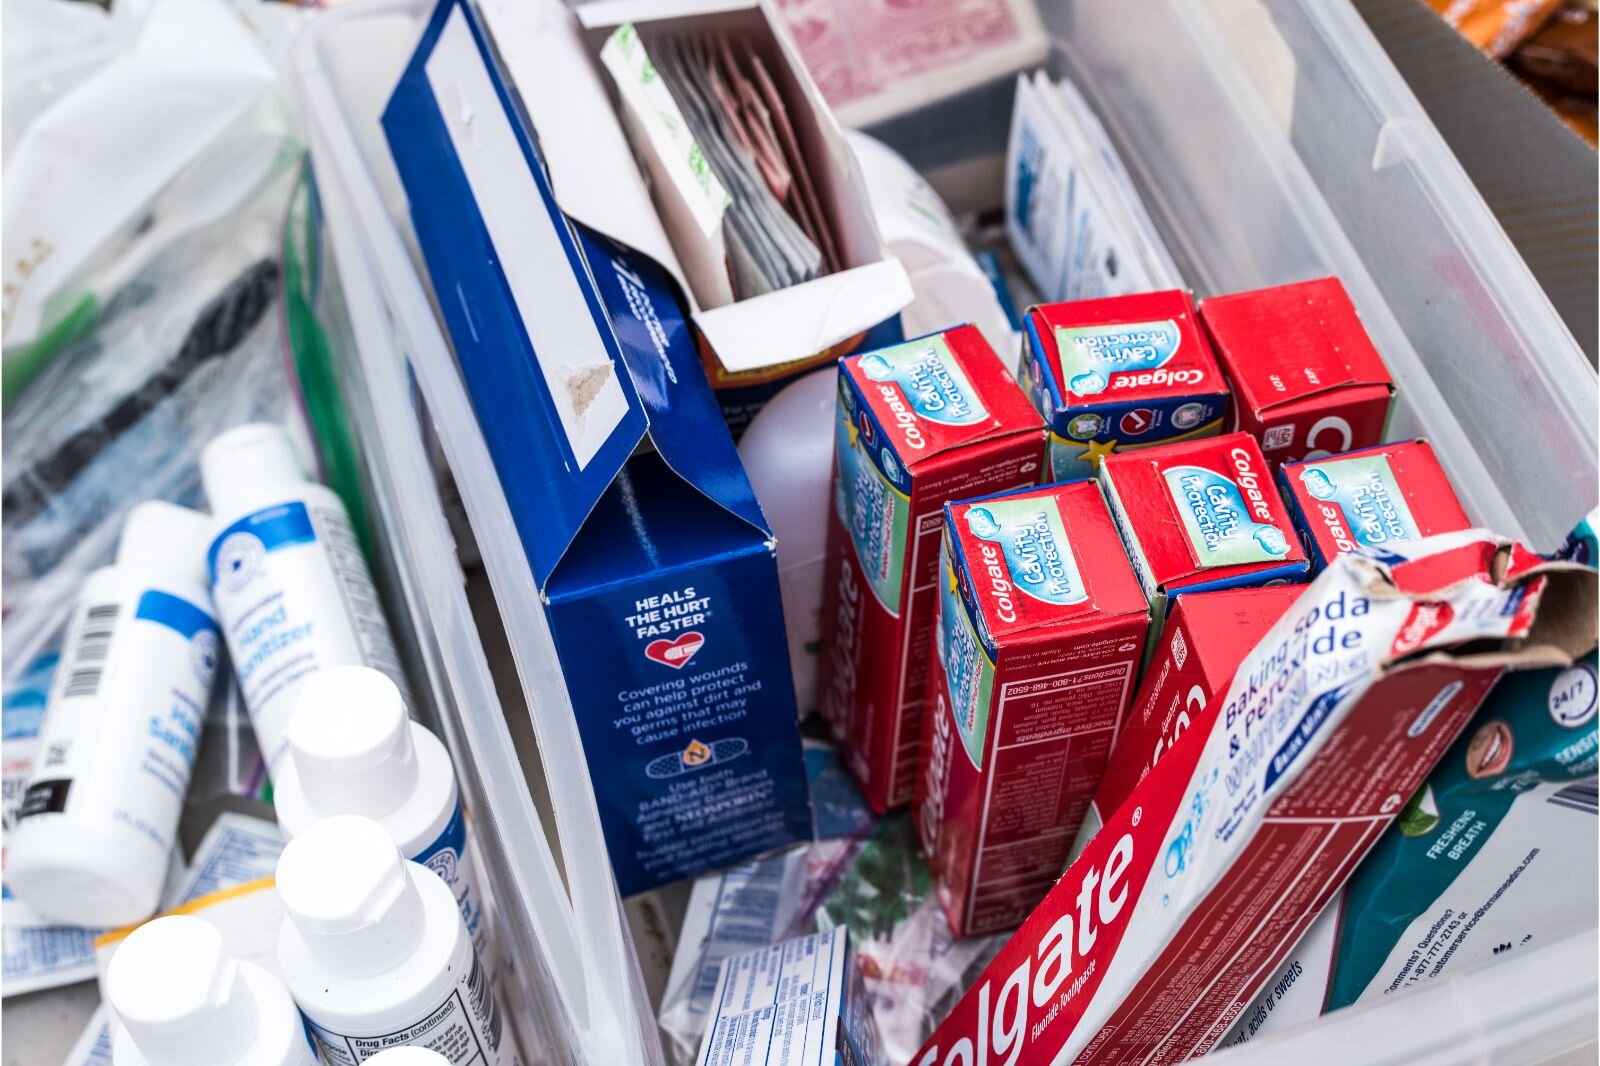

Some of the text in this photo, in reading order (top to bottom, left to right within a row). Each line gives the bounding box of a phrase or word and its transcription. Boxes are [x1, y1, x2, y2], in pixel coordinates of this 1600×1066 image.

[1074, 330, 1168, 347] Protection
[1091, 345, 1157, 364] Cavity
[909, 361, 945, 412] Cavity
[926, 347, 971, 418] Protection
[1114, 369, 1204, 388] Colgate
[880, 384, 926, 449] Colgate
[1231, 447, 1271, 520] Colgate
[1180, 475, 1222, 553] Protection
[1205, 485, 1240, 540] Cavity
[1321, 505, 1357, 556] lgate
[1353, 485, 1387, 543] Cavity
[1014, 524, 1045, 584] Cavity
[1034, 512, 1071, 595] Protection
[635, 587, 696, 612] HEALS
[981, 544, 1018, 623] Colgate
[625, 596, 711, 628] THE HURT
[636, 613, 706, 639] FASTER
[949, 616, 969, 686] Cavity
[1225, 640, 1288, 731] Baking
[1294, 590, 1370, 642] soda
[613, 680, 762, 729] you against dirt and
[618, 661, 748, 702] Covering wounds
[623, 673, 745, 713] can help protect
[1229, 734, 1240, 759] &
[1244, 625, 1362, 738] Peroxide
[1552, 680, 1584, 709] 24/7
[630, 697, 747, 736] germs that may
[635, 708, 748, 745] cause infection
[1017, 717, 1112, 744] Inactive ingredients
[668, 779, 697, 793] Use
[1426, 808, 1477, 860] FRESHENS
[1447, 820, 1488, 861] BREATH
[1409, 911, 1469, 982] 1-877-777-2743 or
[1417, 908, 1455, 950] Questions?
[1031, 959, 1096, 1043] Fluoride Toothpaste
[1248, 960, 1303, 1036] acids or sweets
[355, 1039, 381, 1049] Drug
[382, 1031, 410, 1047] Facts
[410, 1000, 455, 1038] (continued)
[1150, 1036, 1178, 1065] redients
